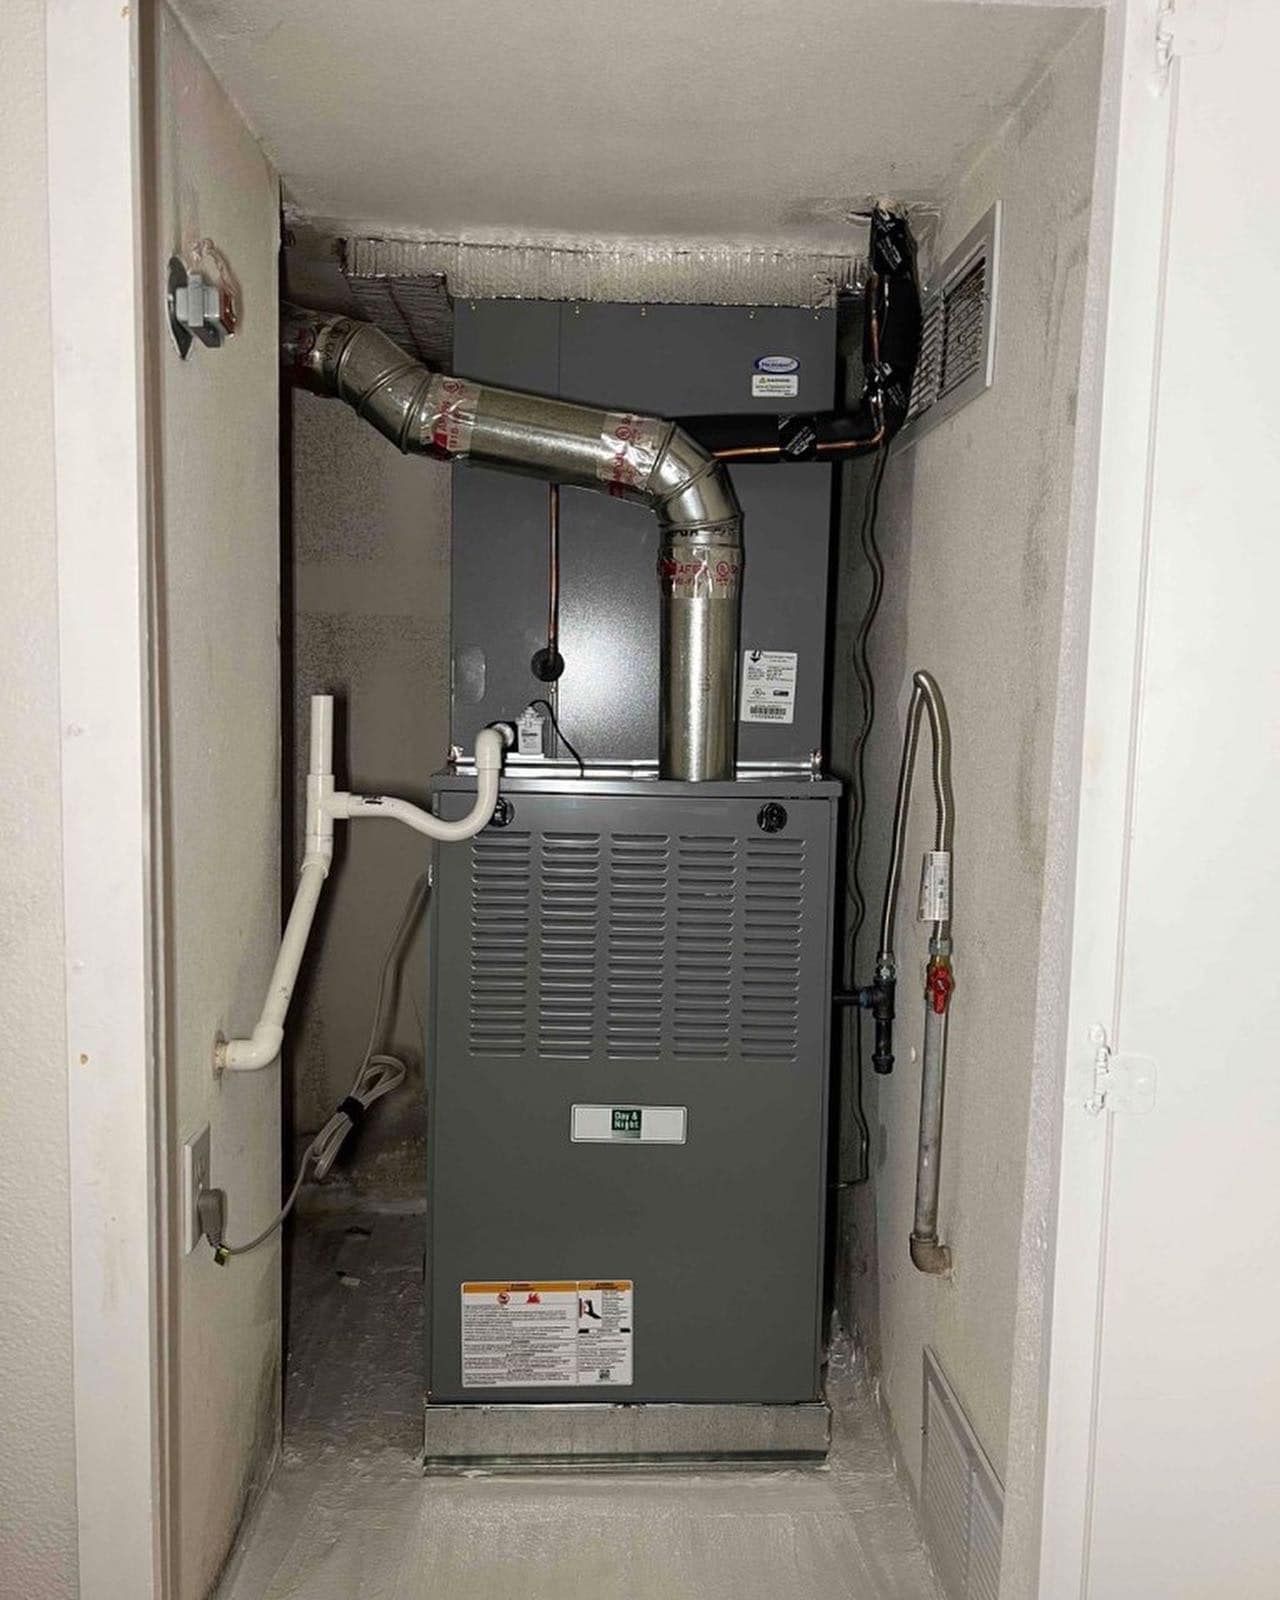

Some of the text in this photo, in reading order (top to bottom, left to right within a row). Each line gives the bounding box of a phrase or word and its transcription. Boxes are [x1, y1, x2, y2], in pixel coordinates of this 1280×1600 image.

[614, 1111, 638, 1120] Day &
[614, 1121, 639, 1130] Night
